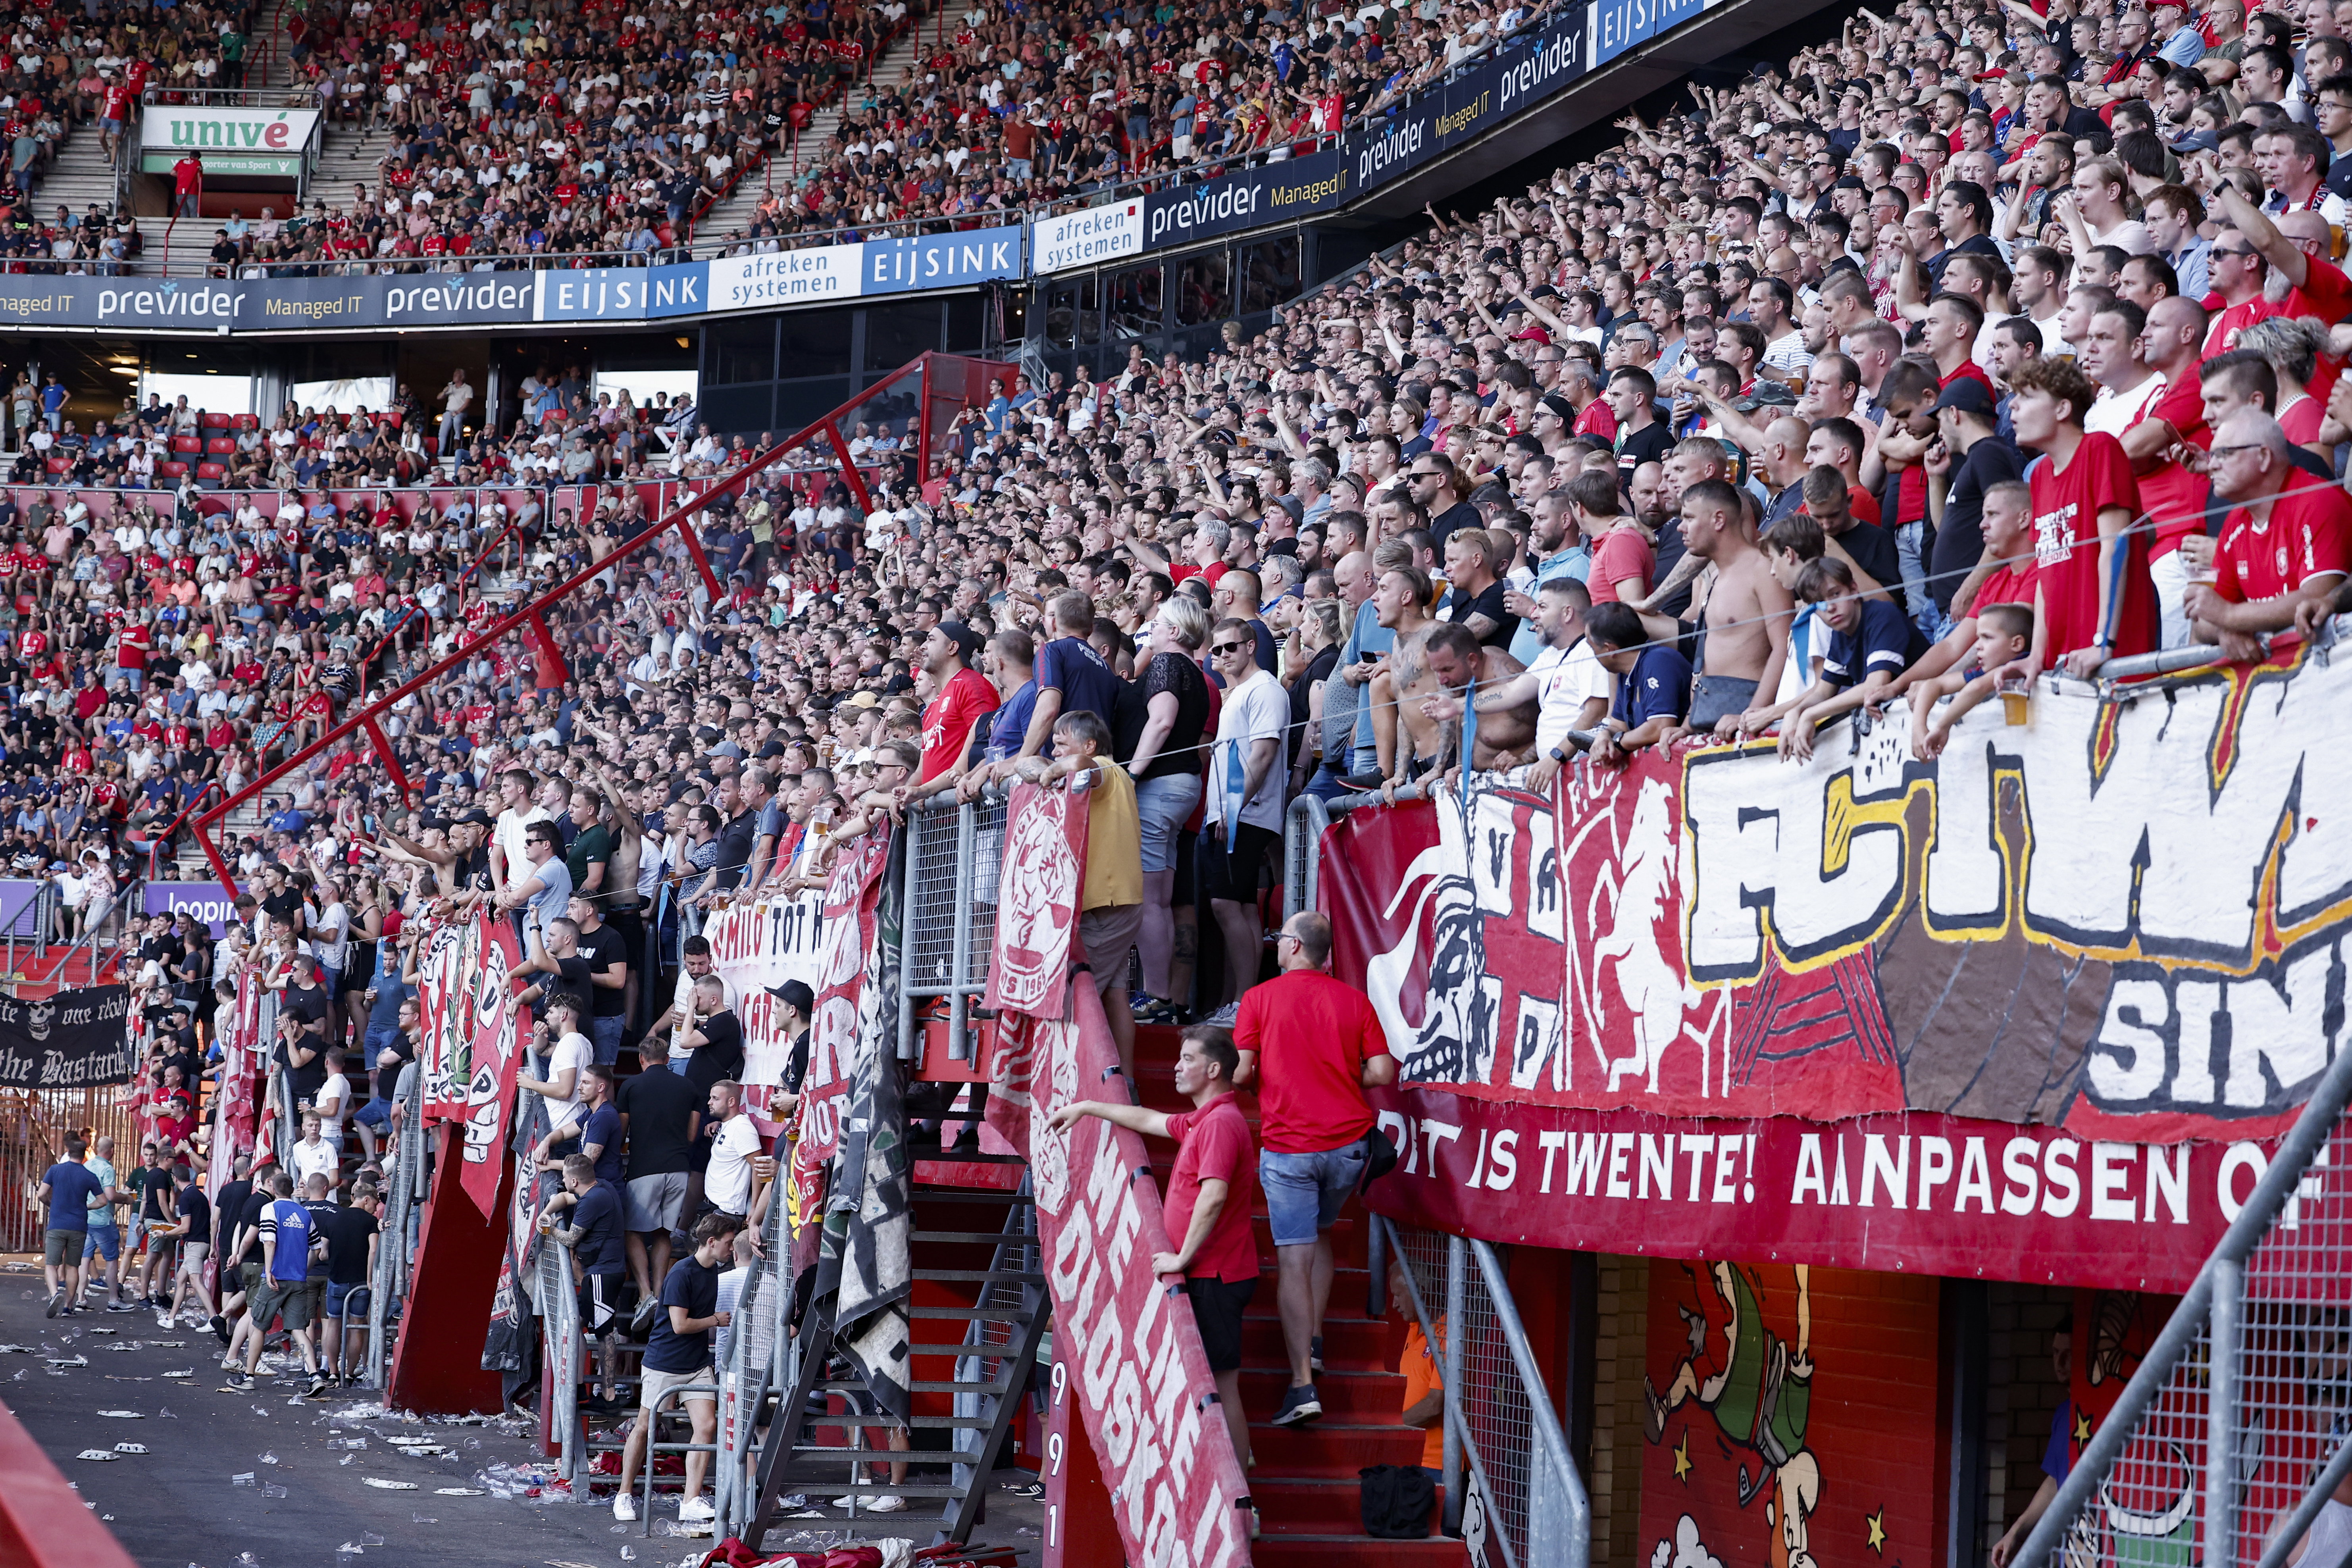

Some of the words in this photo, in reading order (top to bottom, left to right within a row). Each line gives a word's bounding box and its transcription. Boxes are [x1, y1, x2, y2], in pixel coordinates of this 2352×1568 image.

[1501, 29, 1581, 112] previder
[170, 112, 289, 148] univé
[1435, 98, 1478, 139] Managed
[1479, 90, 1490, 115] IT
[248, 161, 271, 170] Sport
[1359, 116, 1426, 188] previder
[1271, 173, 1337, 208] Managed
[1339, 169, 1348, 191] IT
[1056, 212, 1124, 242] afreken
[1151, 183, 1261, 242] previder
[743, 254, 827, 278] afreken
[1047, 231, 1132, 269] systemen
[57, 295, 74, 312] IT
[98, 286, 246, 319] previder
[265, 297, 343, 319] Managed
[347, 297, 363, 314] IT
[387, 279, 532, 318] previder
[732, 275, 837, 305] systemen
[168, 892, 247, 930] loopin
[772, 904, 805, 955] TOT
[61, 1007, 92, 1025] one
[2086, 952, 2336, 1109] SIN
[1378, 1109, 1463, 1178] DIT
[1465, 1128, 1519, 1191] IS
[1538, 1130, 1757, 1204] TWENTE!
[283, 1221, 305, 1229] adidas
[727, 1400, 734, 1420] 10
